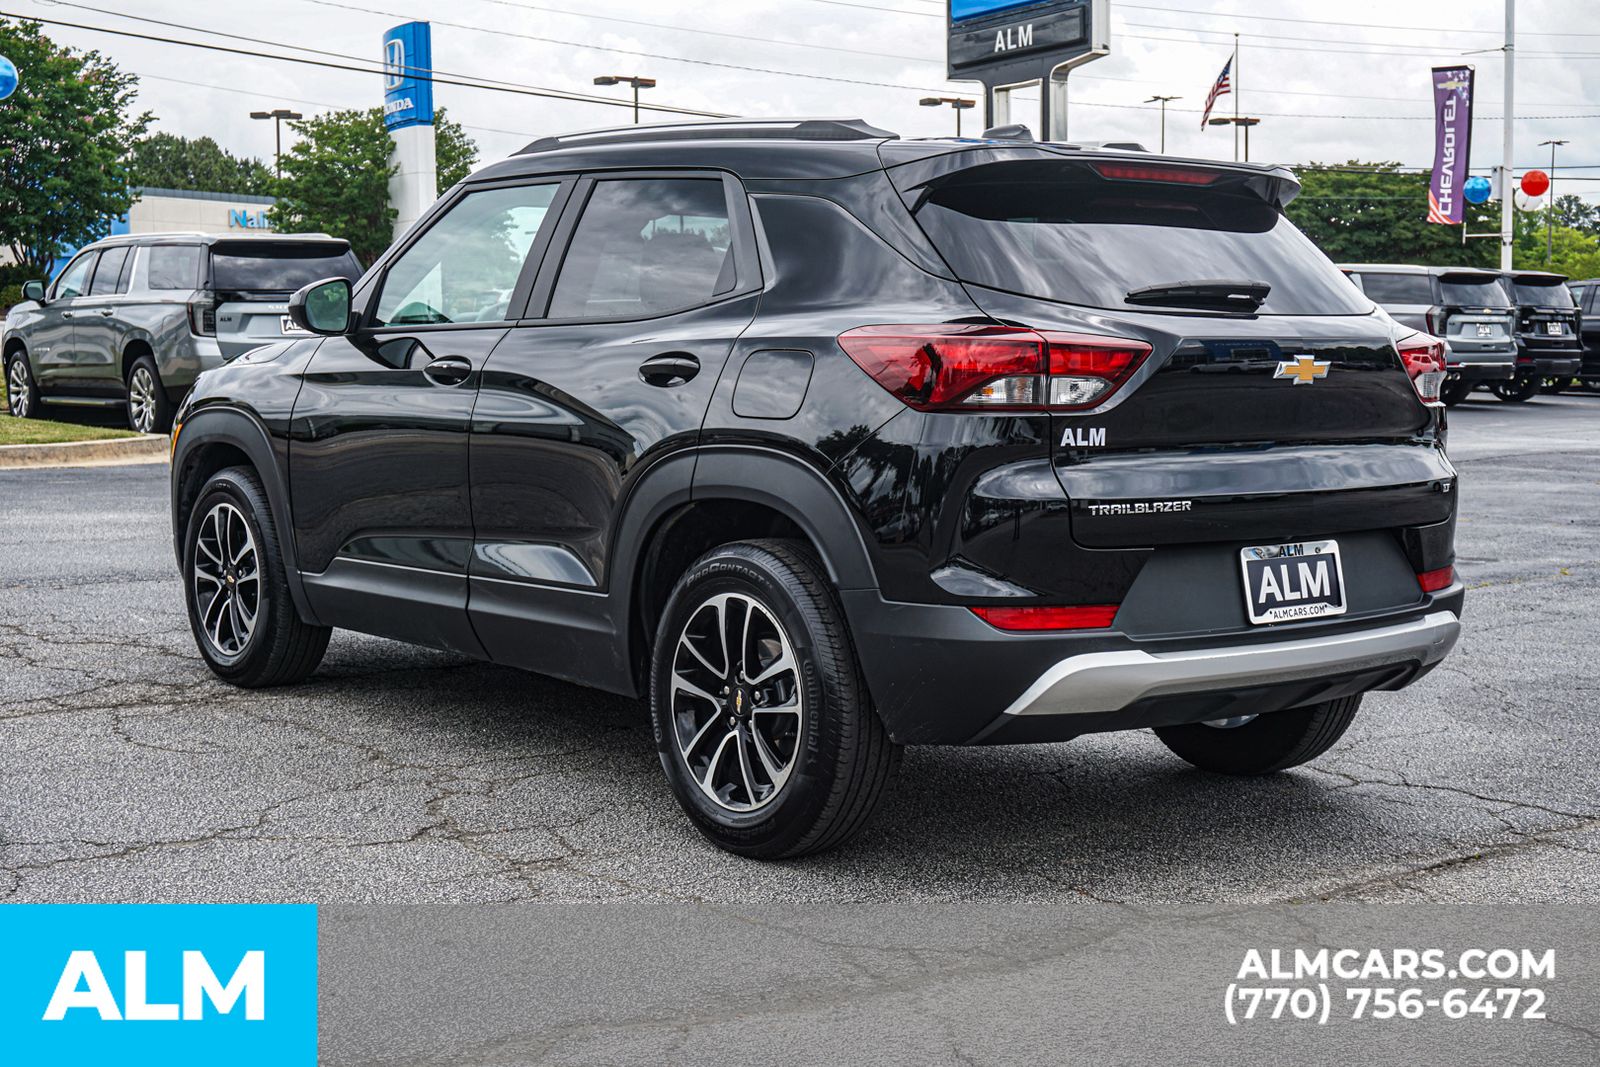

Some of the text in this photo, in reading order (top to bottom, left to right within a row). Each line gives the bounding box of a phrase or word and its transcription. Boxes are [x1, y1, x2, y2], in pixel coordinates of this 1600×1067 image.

[994, 24, 1033, 53] ALM
[1060, 427, 1107, 447] ALM
[1088, 500, 1193, 516] TRAILBLAZER
[1279, 543, 1304, 558] ALM
[1258, 560, 1331, 604] ALM
